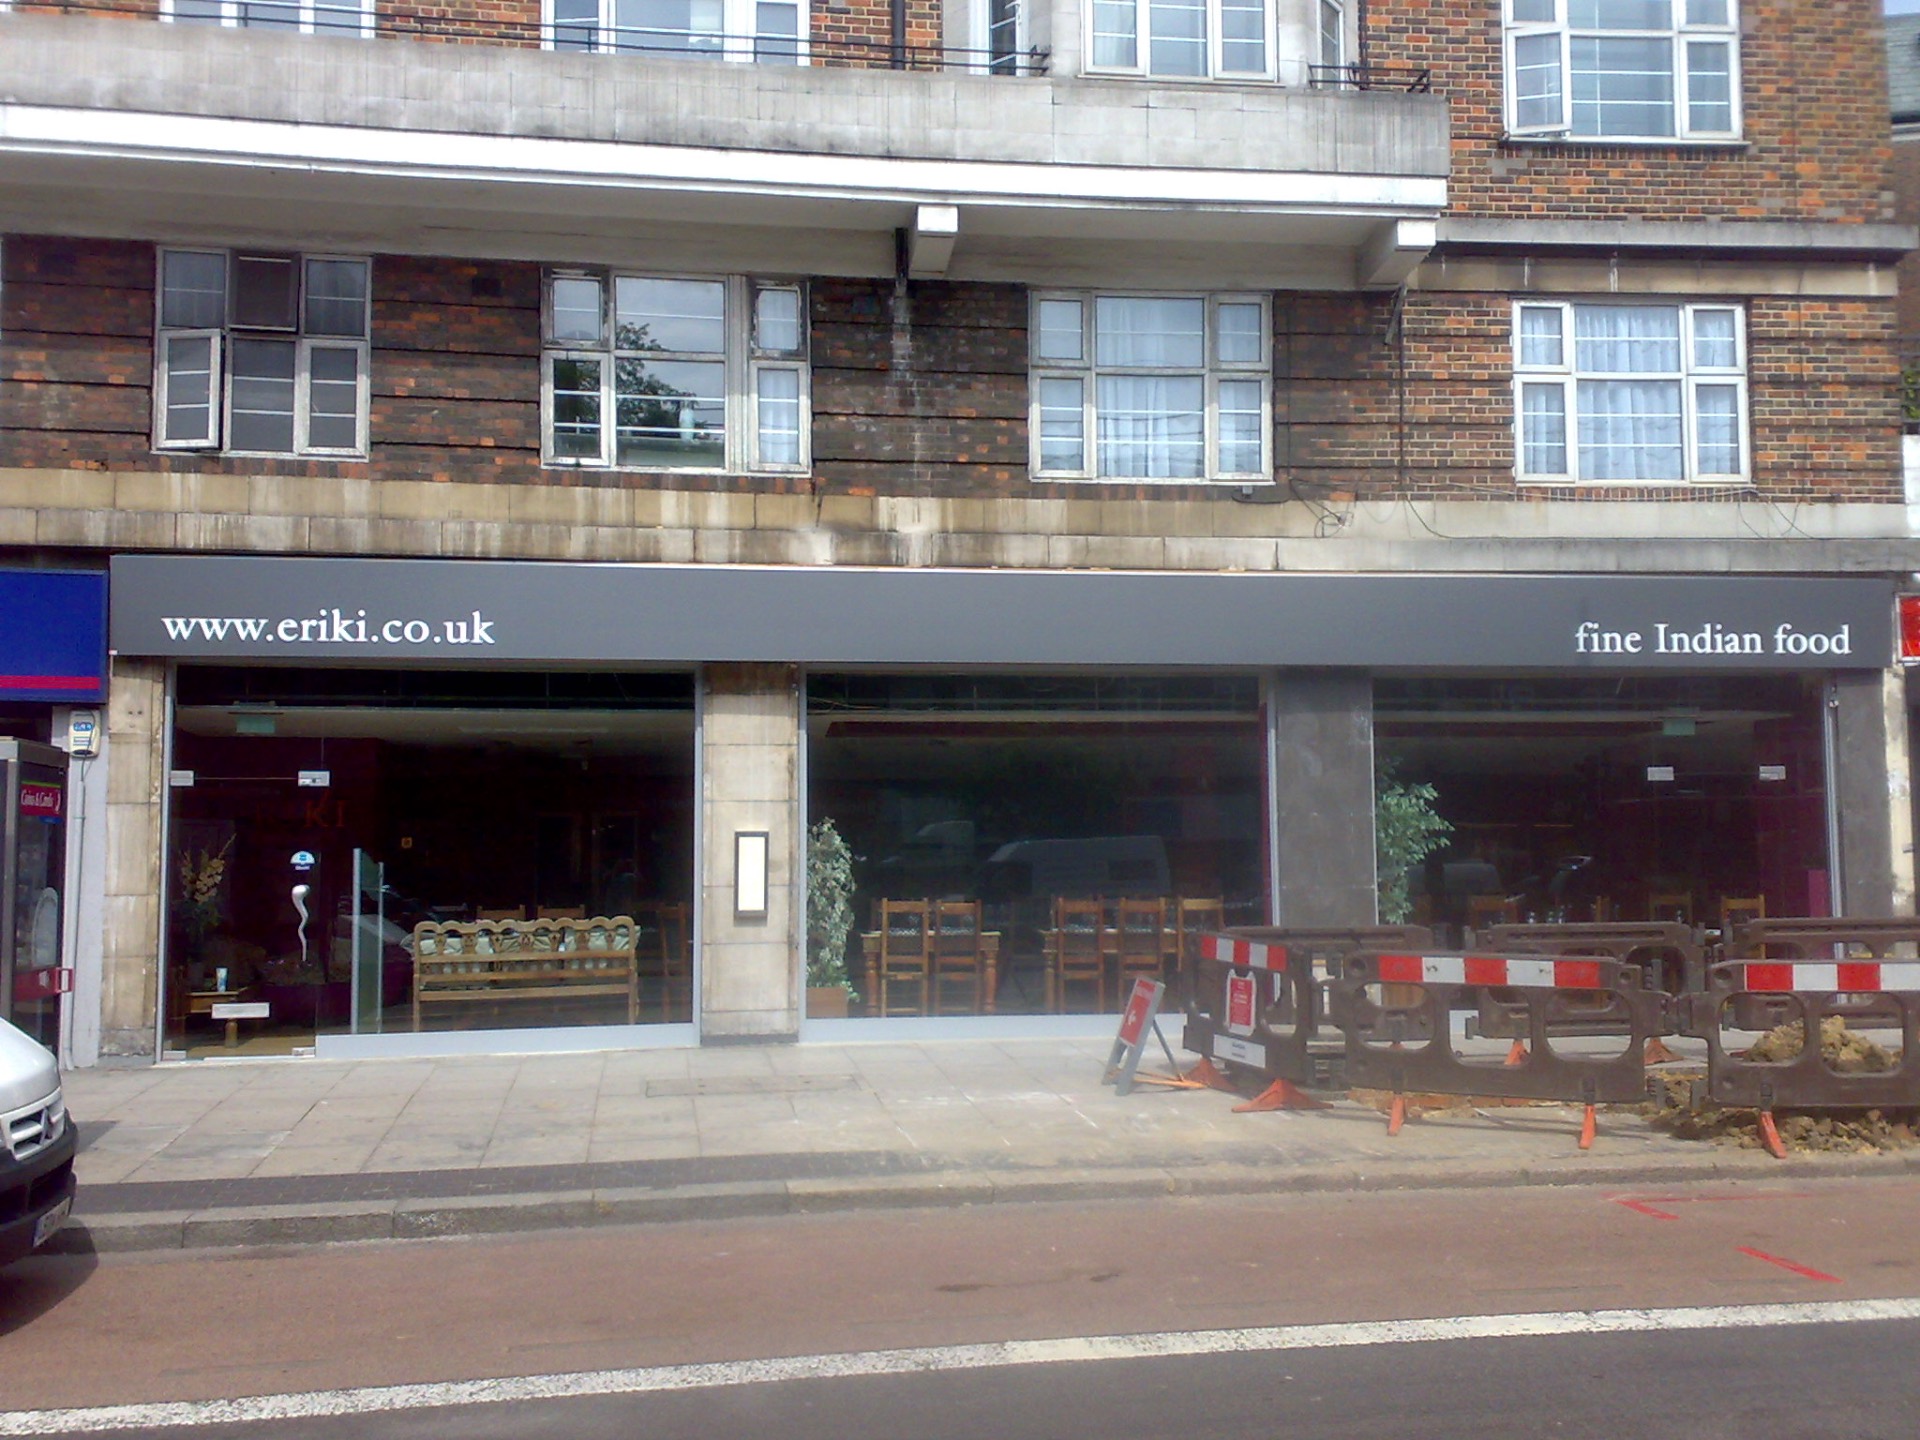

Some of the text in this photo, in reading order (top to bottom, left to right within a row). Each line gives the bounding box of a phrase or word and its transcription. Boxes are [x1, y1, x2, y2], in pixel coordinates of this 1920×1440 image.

[161, 609, 496, 644] www.eriki.co.uk
[1575, 622, 1852, 655] fine Indian food
